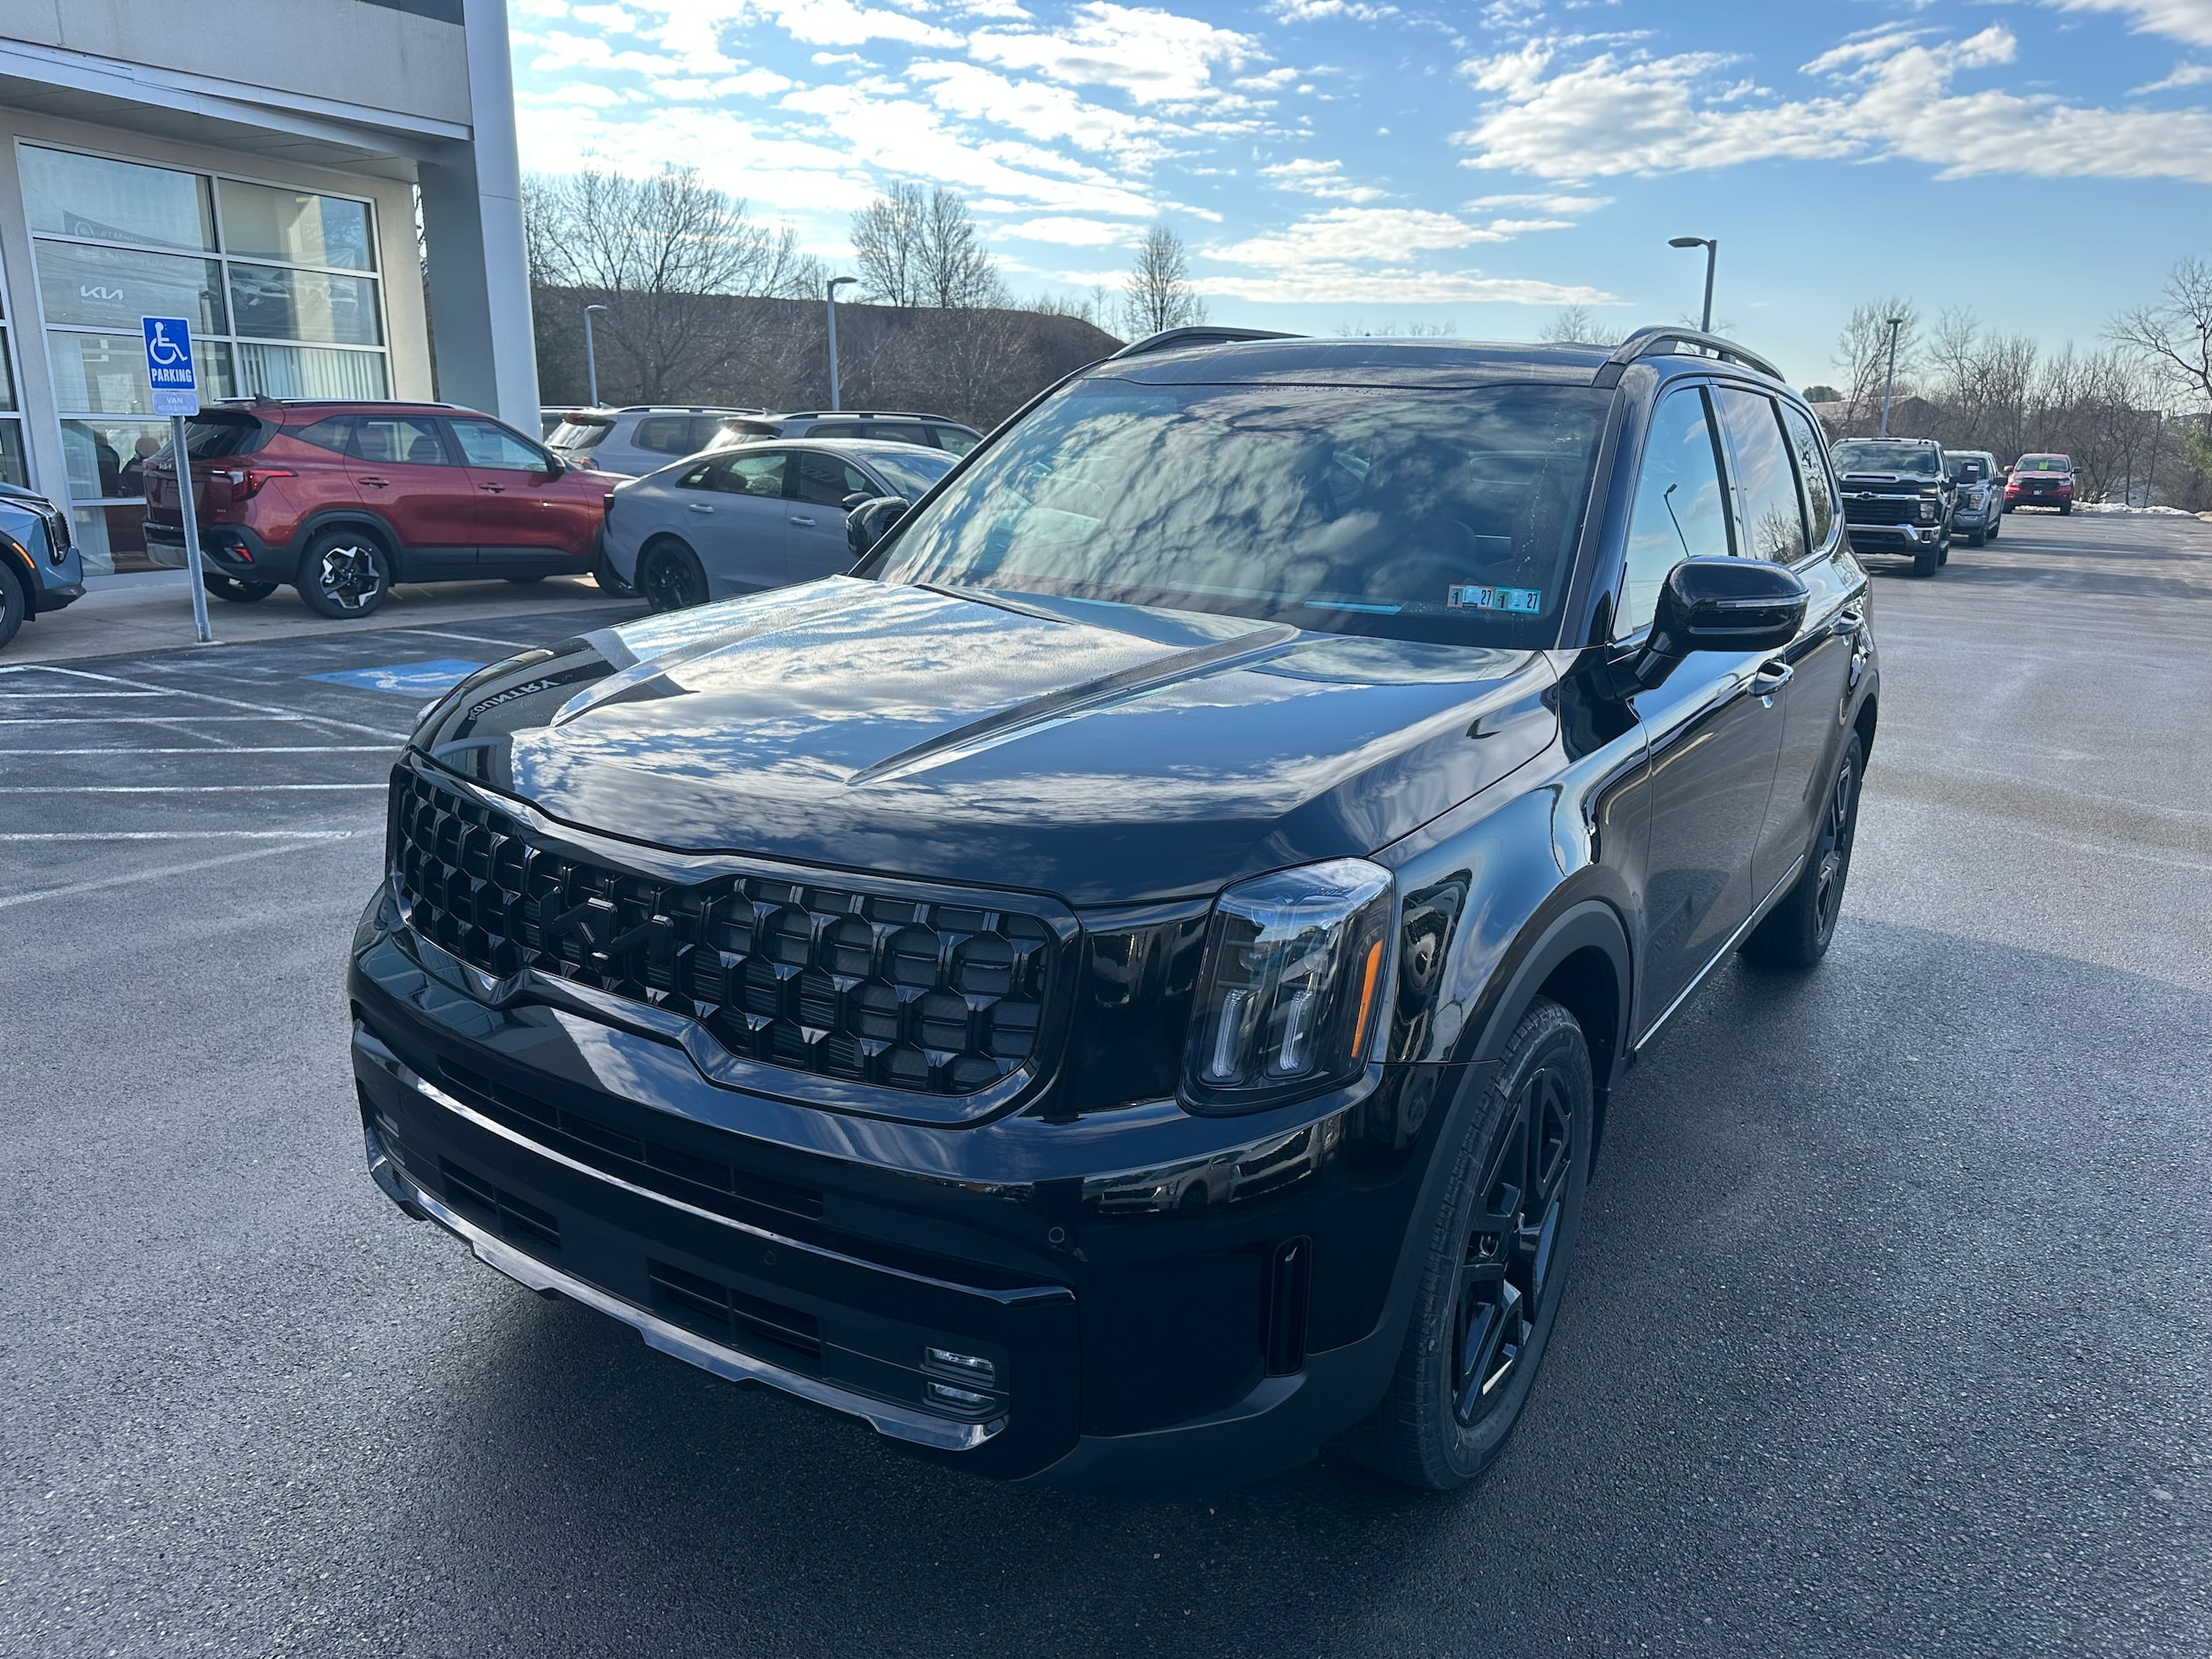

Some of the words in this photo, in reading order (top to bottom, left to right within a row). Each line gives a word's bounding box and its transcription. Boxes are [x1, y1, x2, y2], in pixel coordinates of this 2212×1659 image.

[80, 285, 124, 301] KIA
[151, 368, 192, 382] PARKING
[1480, 589, 1492, 605] 27
[1526, 593, 1539, 610] 27
